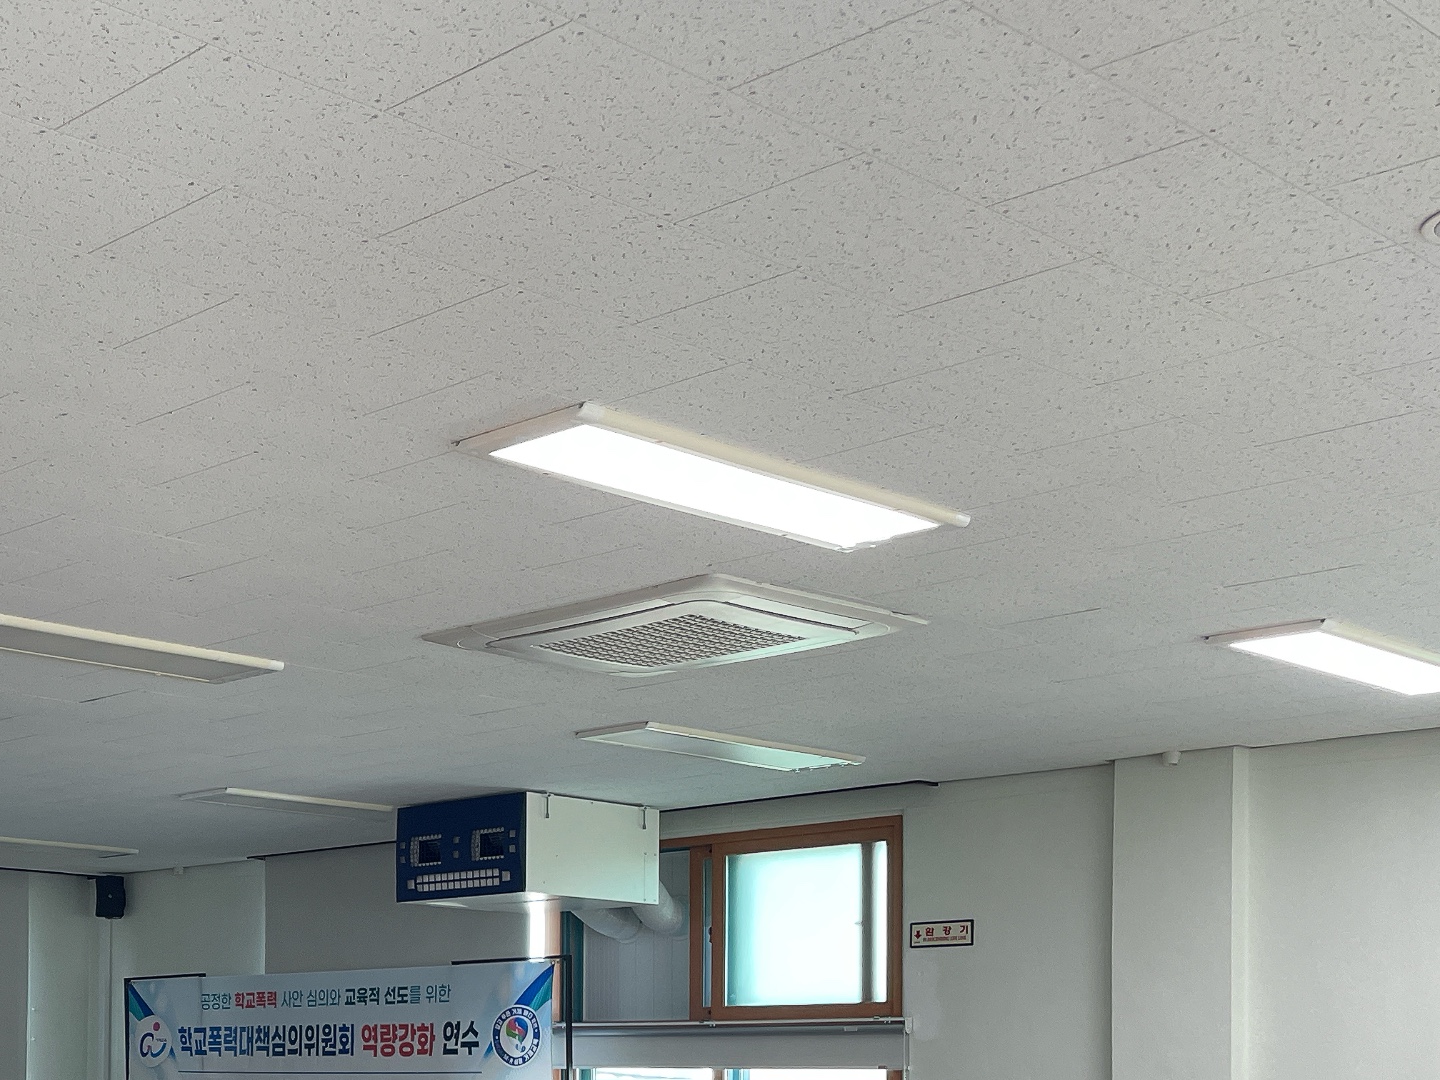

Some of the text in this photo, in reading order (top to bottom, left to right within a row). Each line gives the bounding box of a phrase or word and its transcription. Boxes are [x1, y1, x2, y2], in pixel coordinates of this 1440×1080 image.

[201, 984, 452, 1011] 공정한 학교폭력 사안 심의와 교육적 선도를 위한
[178, 1023, 355, 1057] 학교폭력대책심의위원회
[361, 1022, 436, 1058] 역량강화
[442, 1020, 480, 1056] 연수
